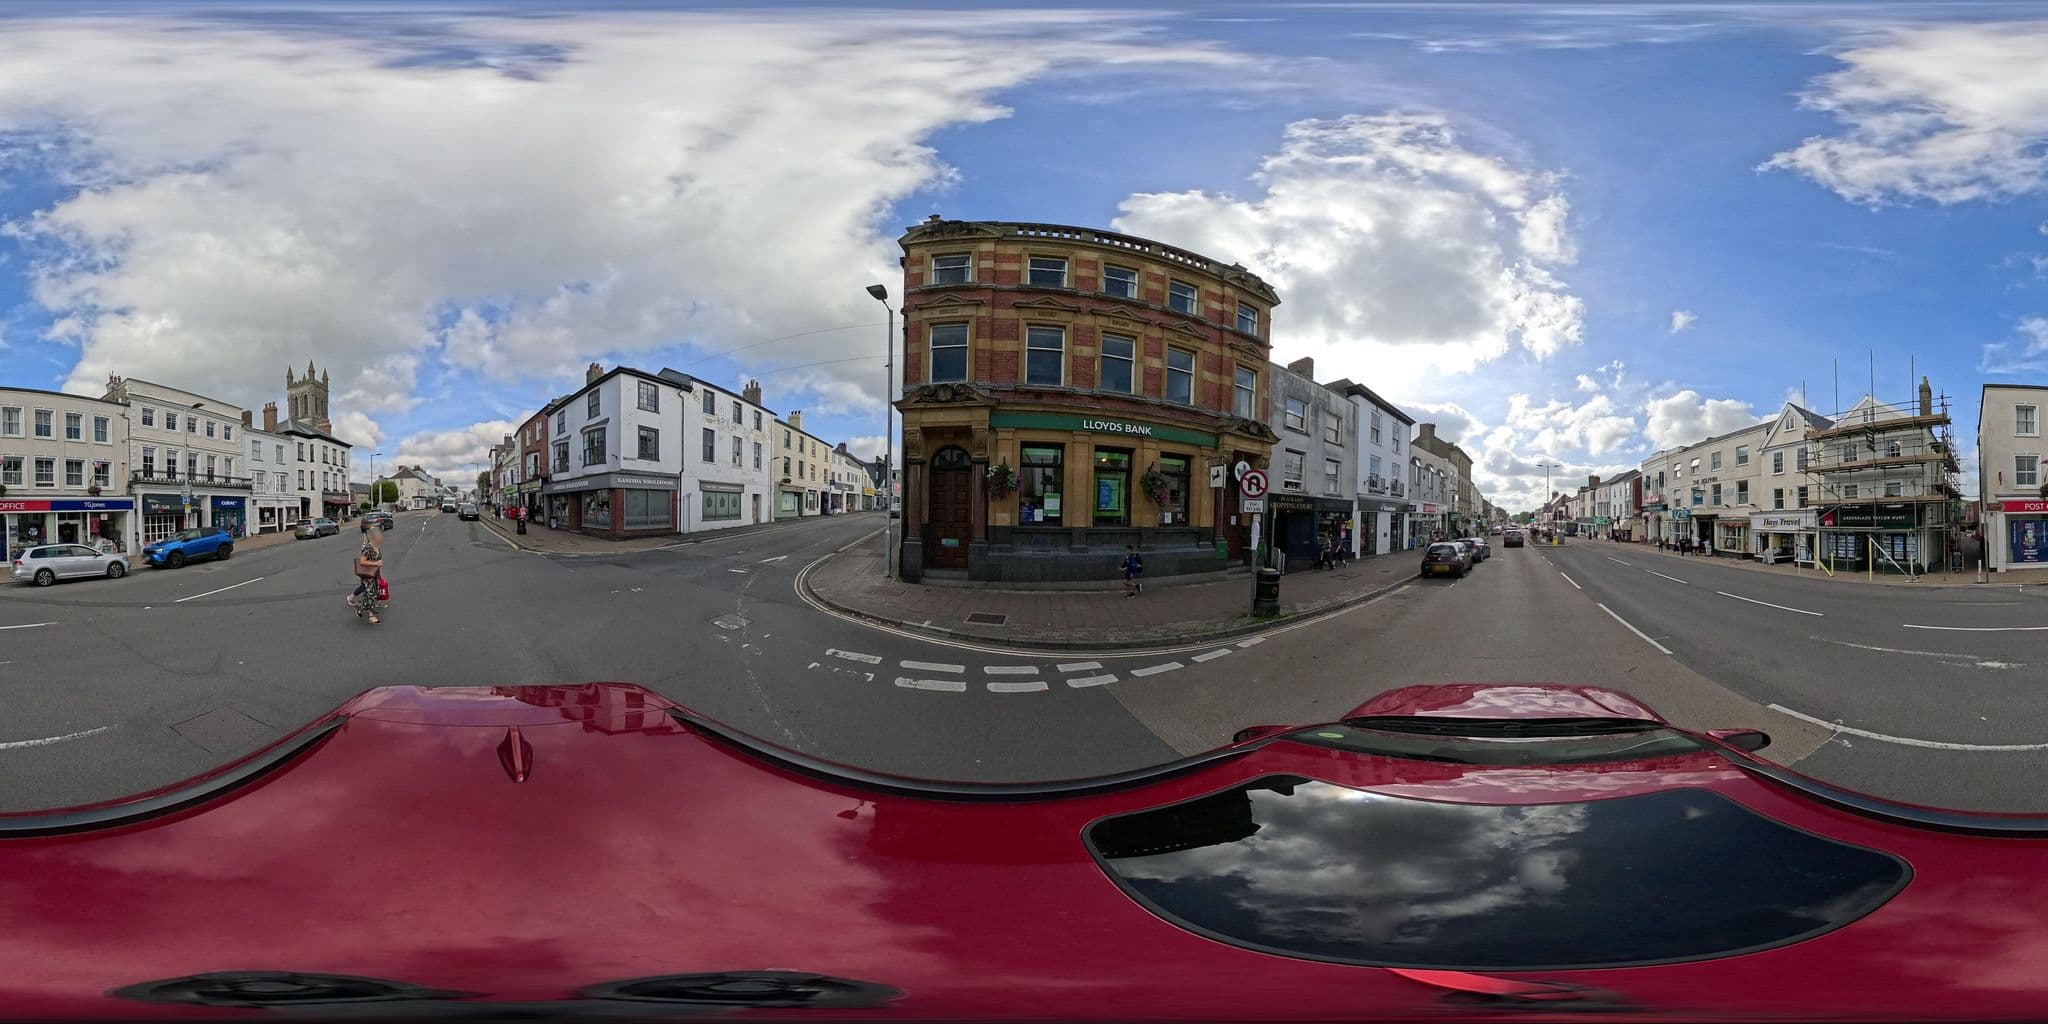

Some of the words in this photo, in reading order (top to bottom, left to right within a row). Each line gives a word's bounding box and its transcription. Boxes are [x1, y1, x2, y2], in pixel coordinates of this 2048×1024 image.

[1083, 420, 1122, 432] LLOYDS
[1125, 424, 1152, 435] BANK
[0, 502, 25, 510] OFFICE
[2024, 503, 2045, 511] POST
[1763, 518, 1779, 528] Hays
[1779, 518, 1800, 526] Travel
